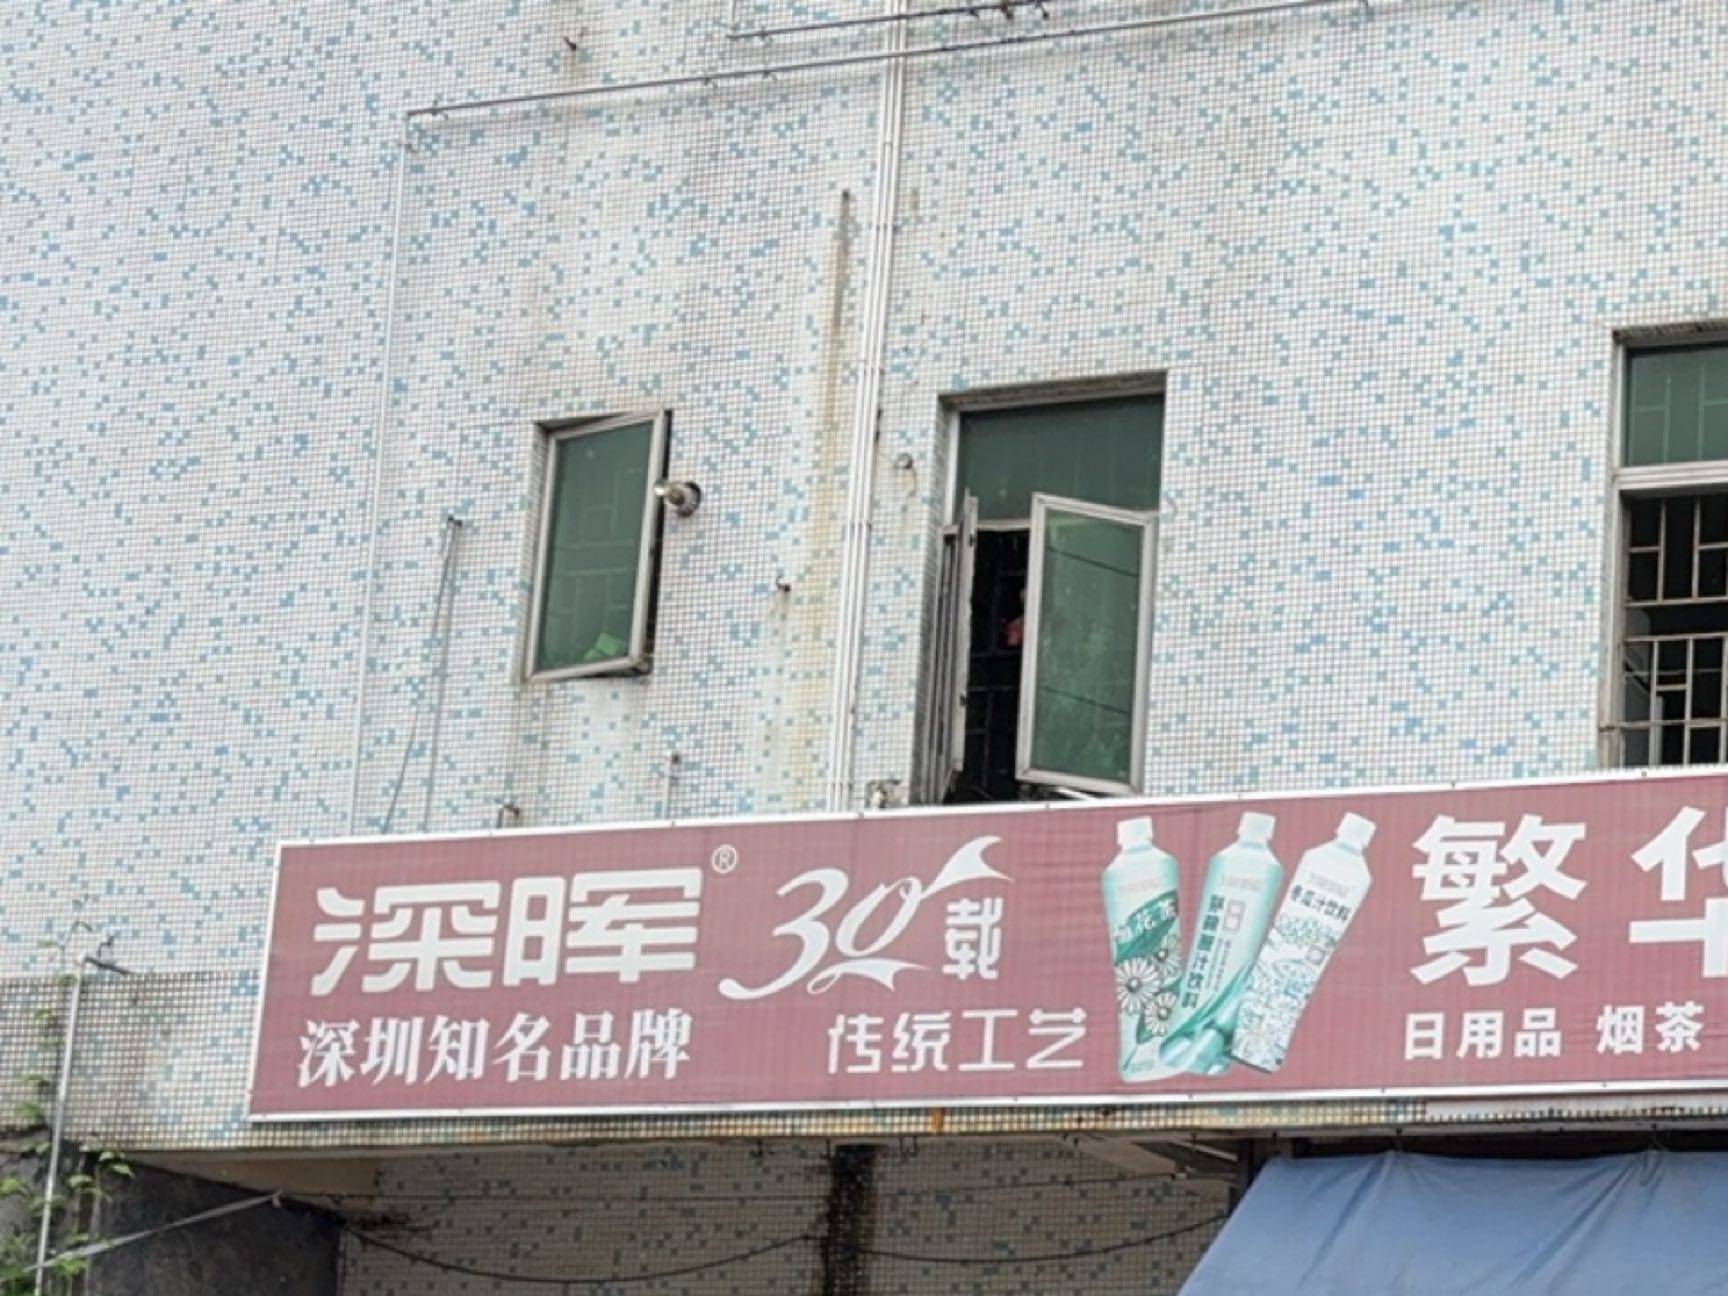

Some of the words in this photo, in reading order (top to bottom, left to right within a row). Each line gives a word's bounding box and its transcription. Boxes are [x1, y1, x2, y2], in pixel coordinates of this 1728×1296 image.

[310, 866, 702, 996] 深晖
[297, 1008, 693, 1088] 深圳知名品牌
[827, 1007, 1088, 1076] 传统工艺
[1404, 1006, 1562, 1062] 日用品
[1596, 1001, 1705, 1057] 烟茶
